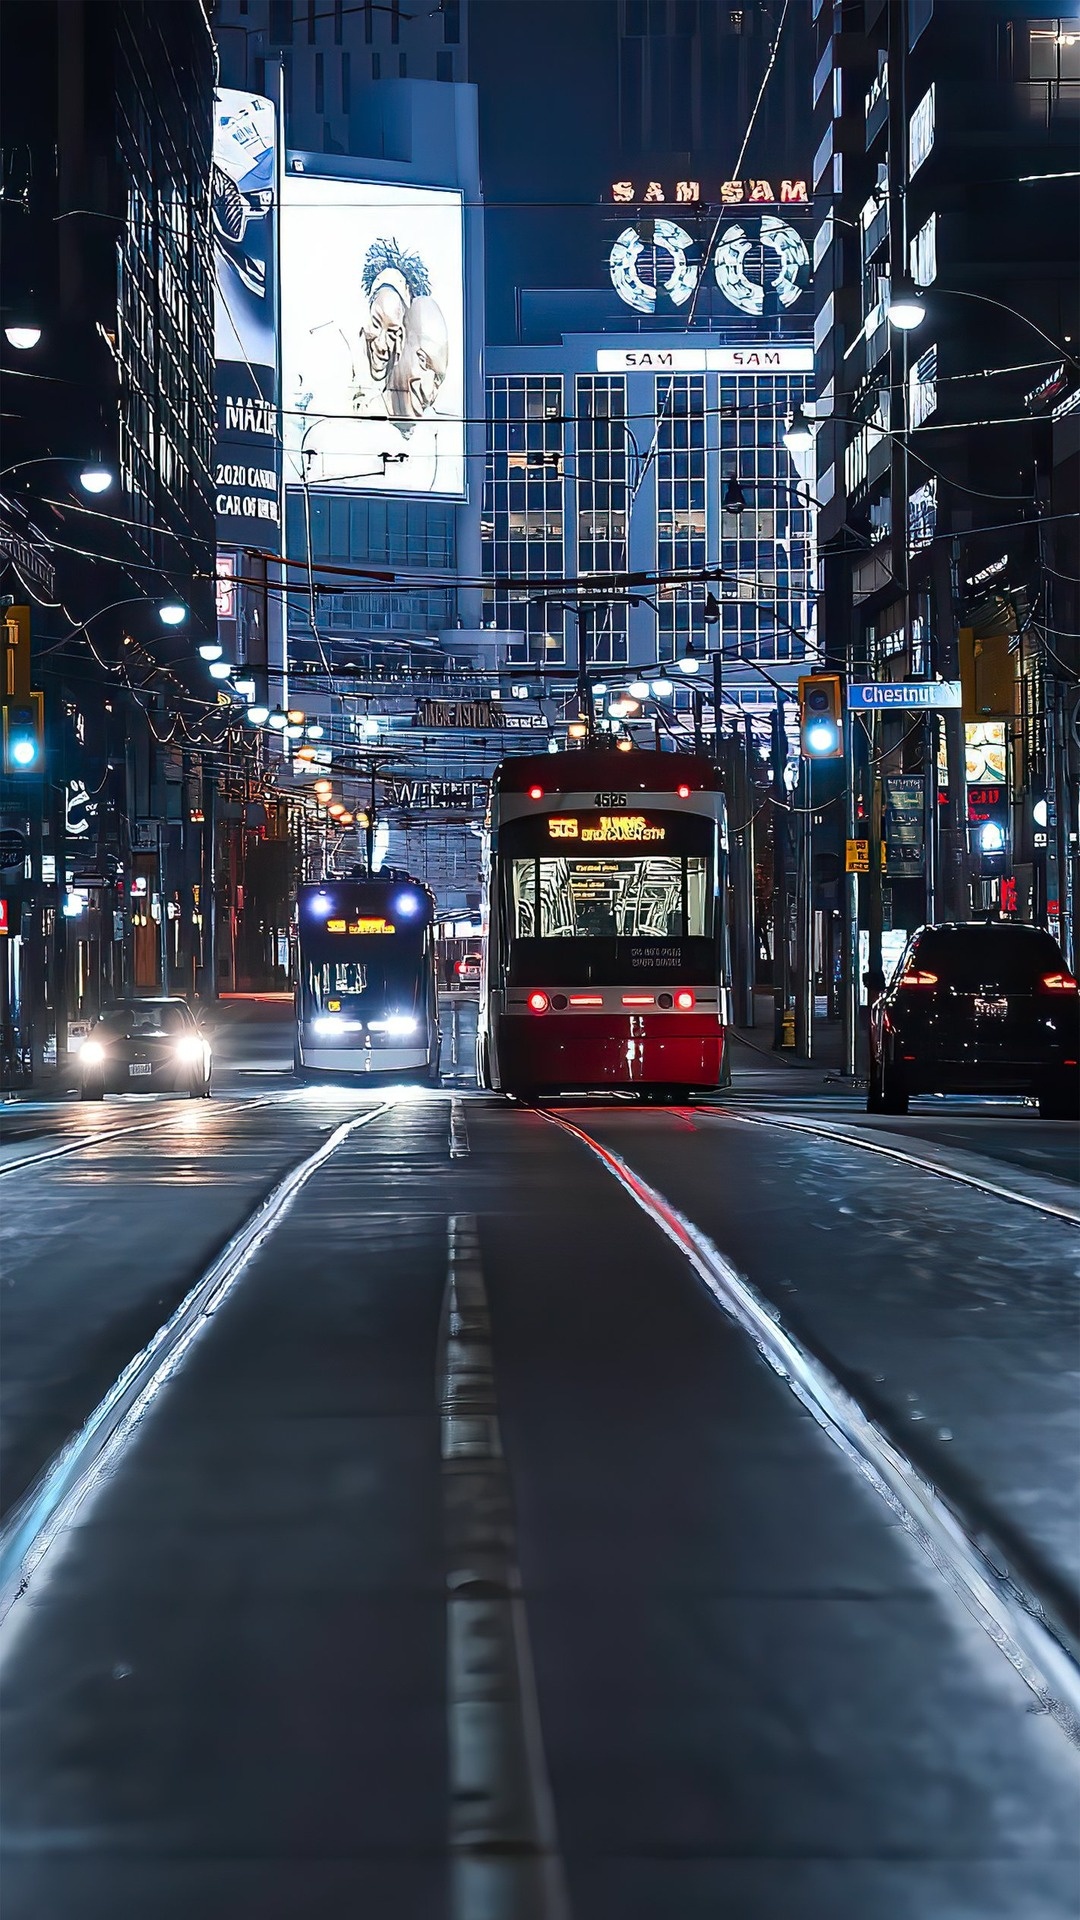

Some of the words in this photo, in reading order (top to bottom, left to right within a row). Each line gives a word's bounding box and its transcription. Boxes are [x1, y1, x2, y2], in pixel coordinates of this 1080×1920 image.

[612, 181, 700, 202] SAM
[720, 180, 809, 202] SAM
[625, 353, 673, 366] SAM
[733, 352, 780, 365] SAM
[216, 494, 242, 516] CAR
